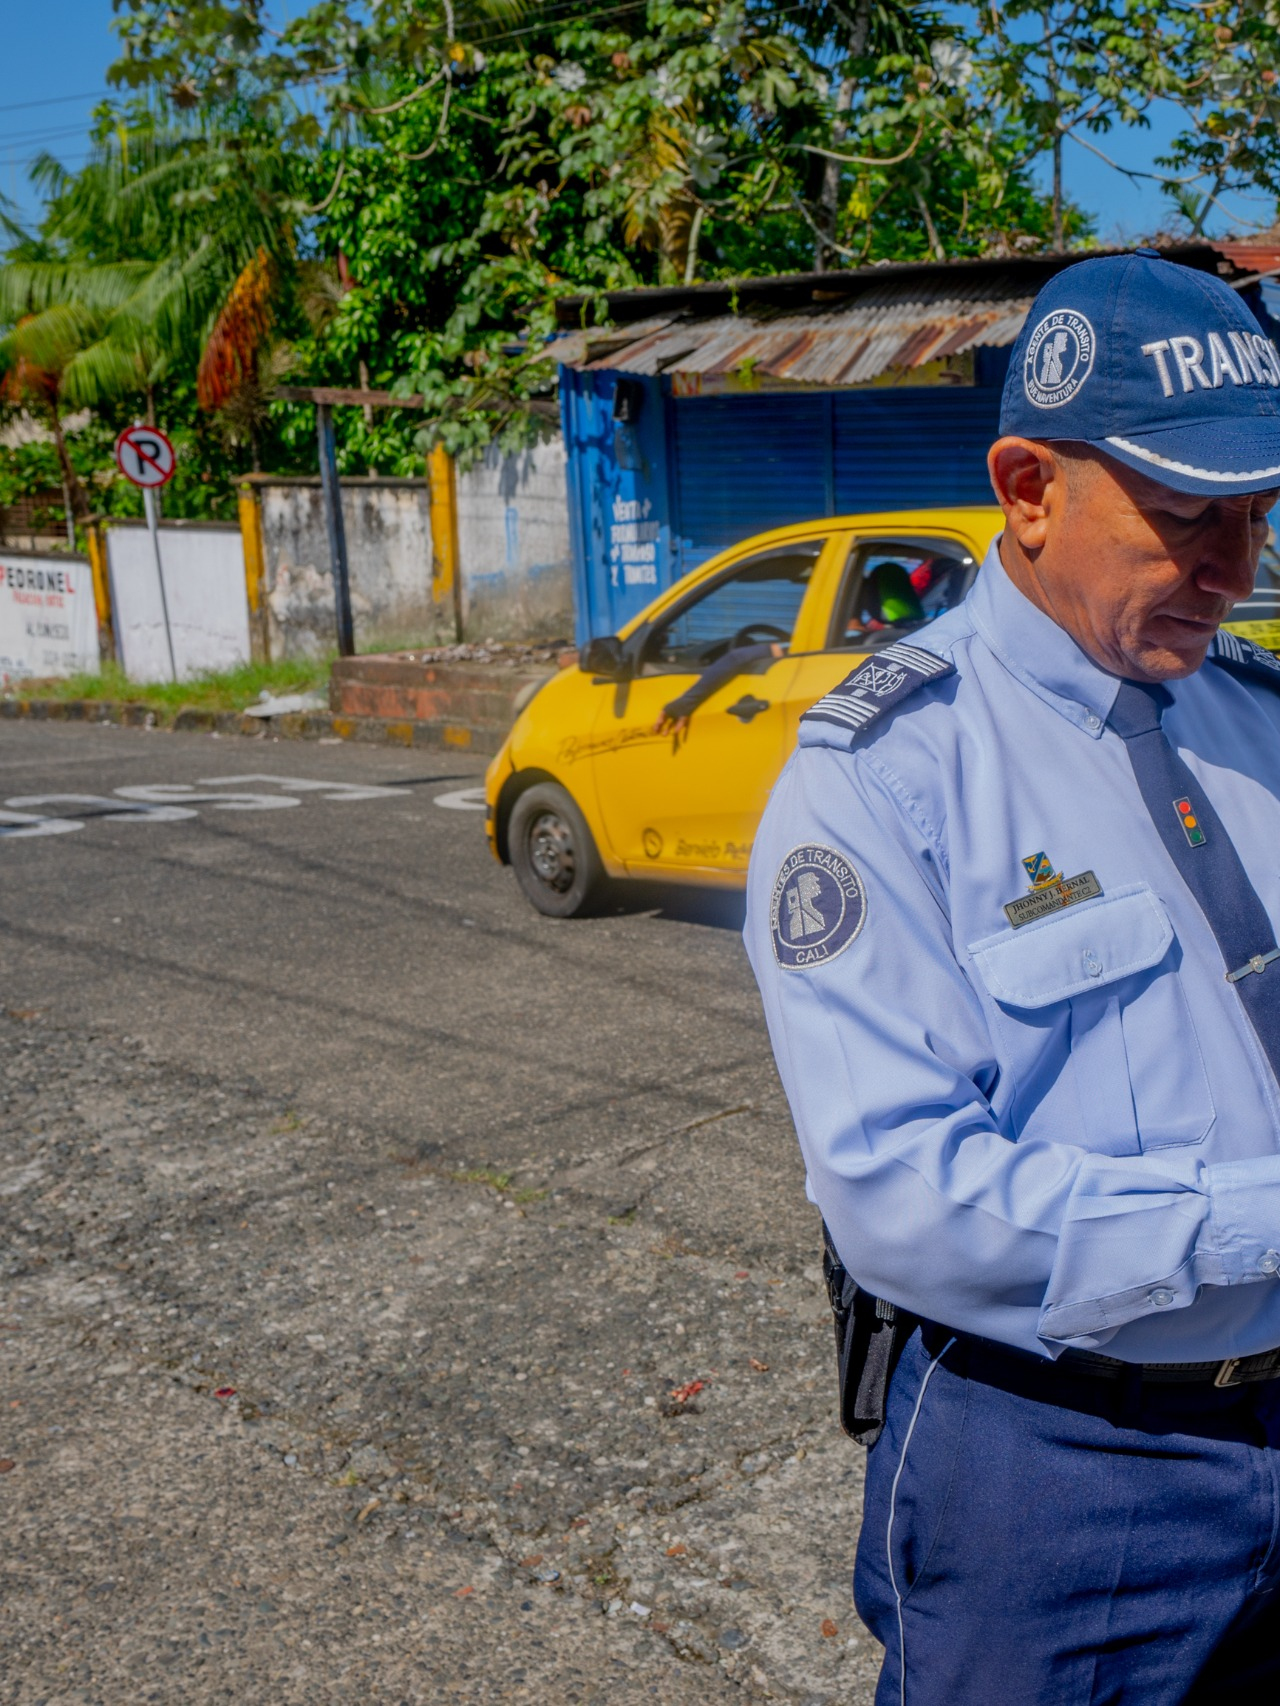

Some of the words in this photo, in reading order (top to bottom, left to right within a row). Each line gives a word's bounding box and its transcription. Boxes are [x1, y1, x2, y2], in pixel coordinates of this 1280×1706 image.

[1051, 314, 1065, 327] DE
[1066, 315, 1090, 362] TRANSITO
[1028, 378, 1079, 404] BUENAVENTURA
[790, 852, 806, 867] DE
[806, 849, 859, 899] TRANSITO
[1012, 891, 1048, 915] JHONNY
[1056, 876, 1090, 895] BERNAL
[1081, 886, 1092, 897] C2
[795, 943, 829, 964] CALI
